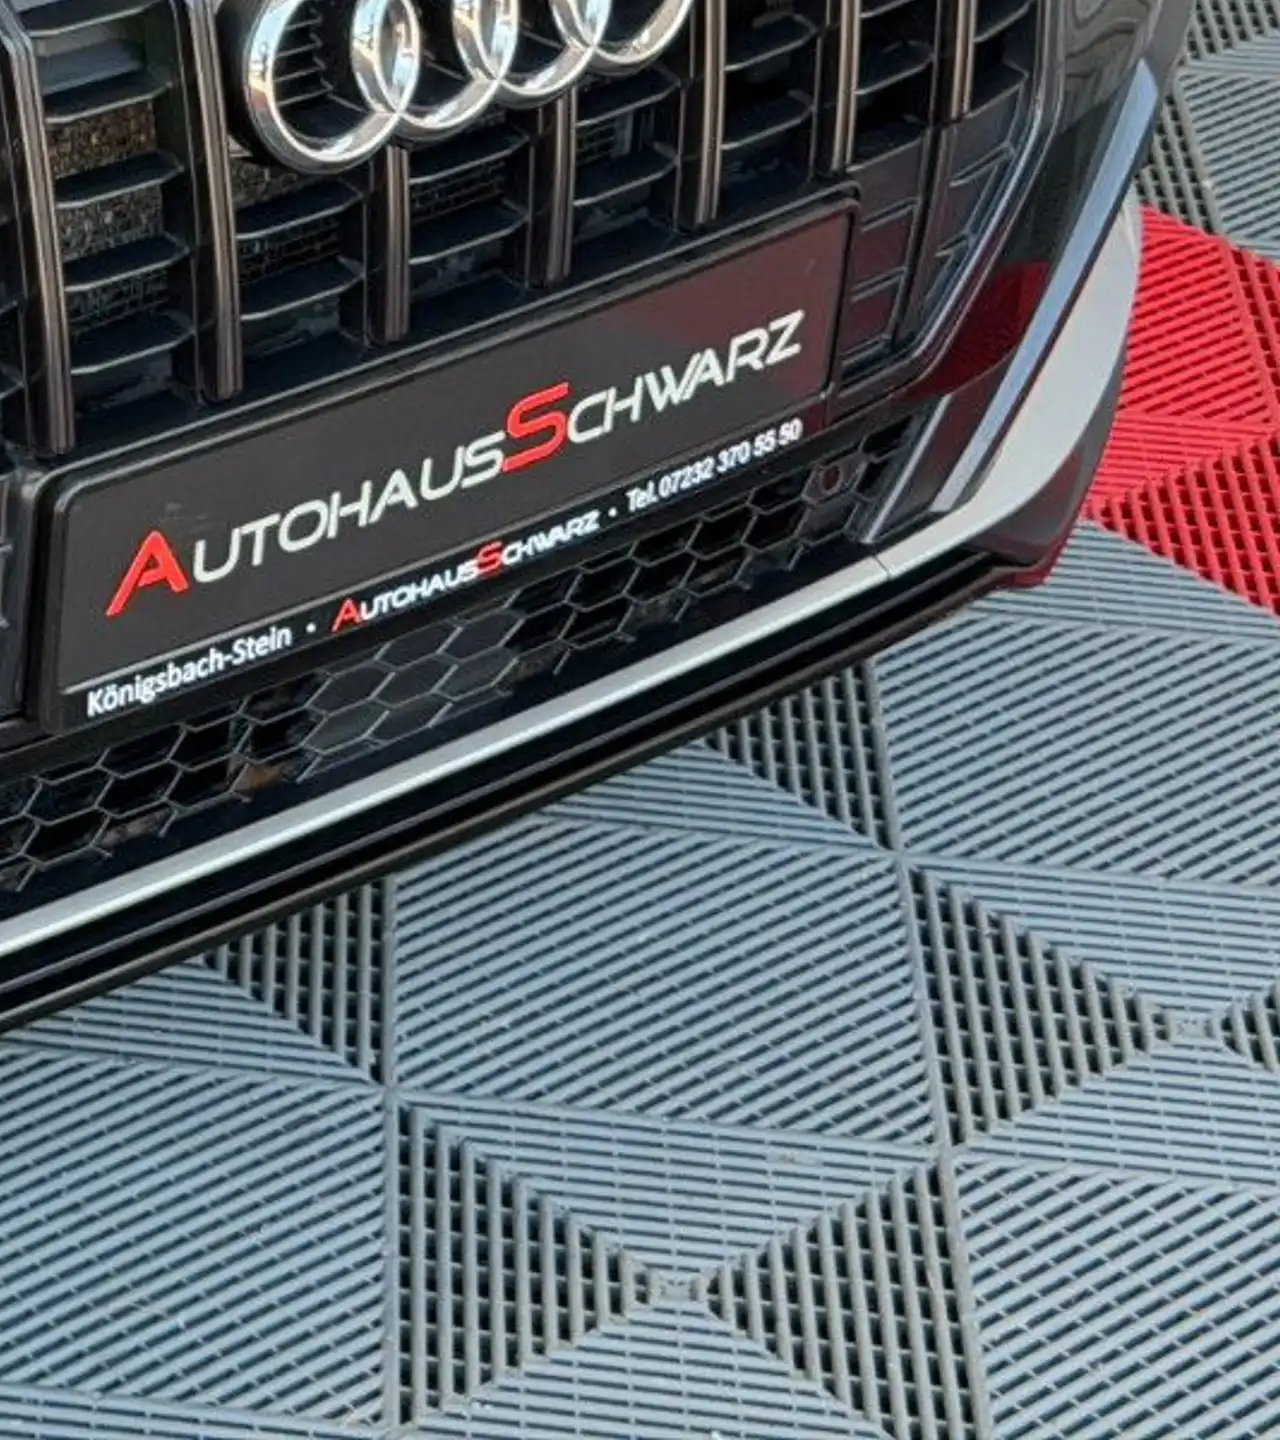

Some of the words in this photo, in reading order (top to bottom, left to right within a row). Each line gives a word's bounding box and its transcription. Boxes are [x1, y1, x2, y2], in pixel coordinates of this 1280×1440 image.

[87, 624, 293, 716] Königsbach-Stein
[716, 441, 752, 472] 370
[753, 428, 777, 457] 55
[778, 417, 803, 445] 50
